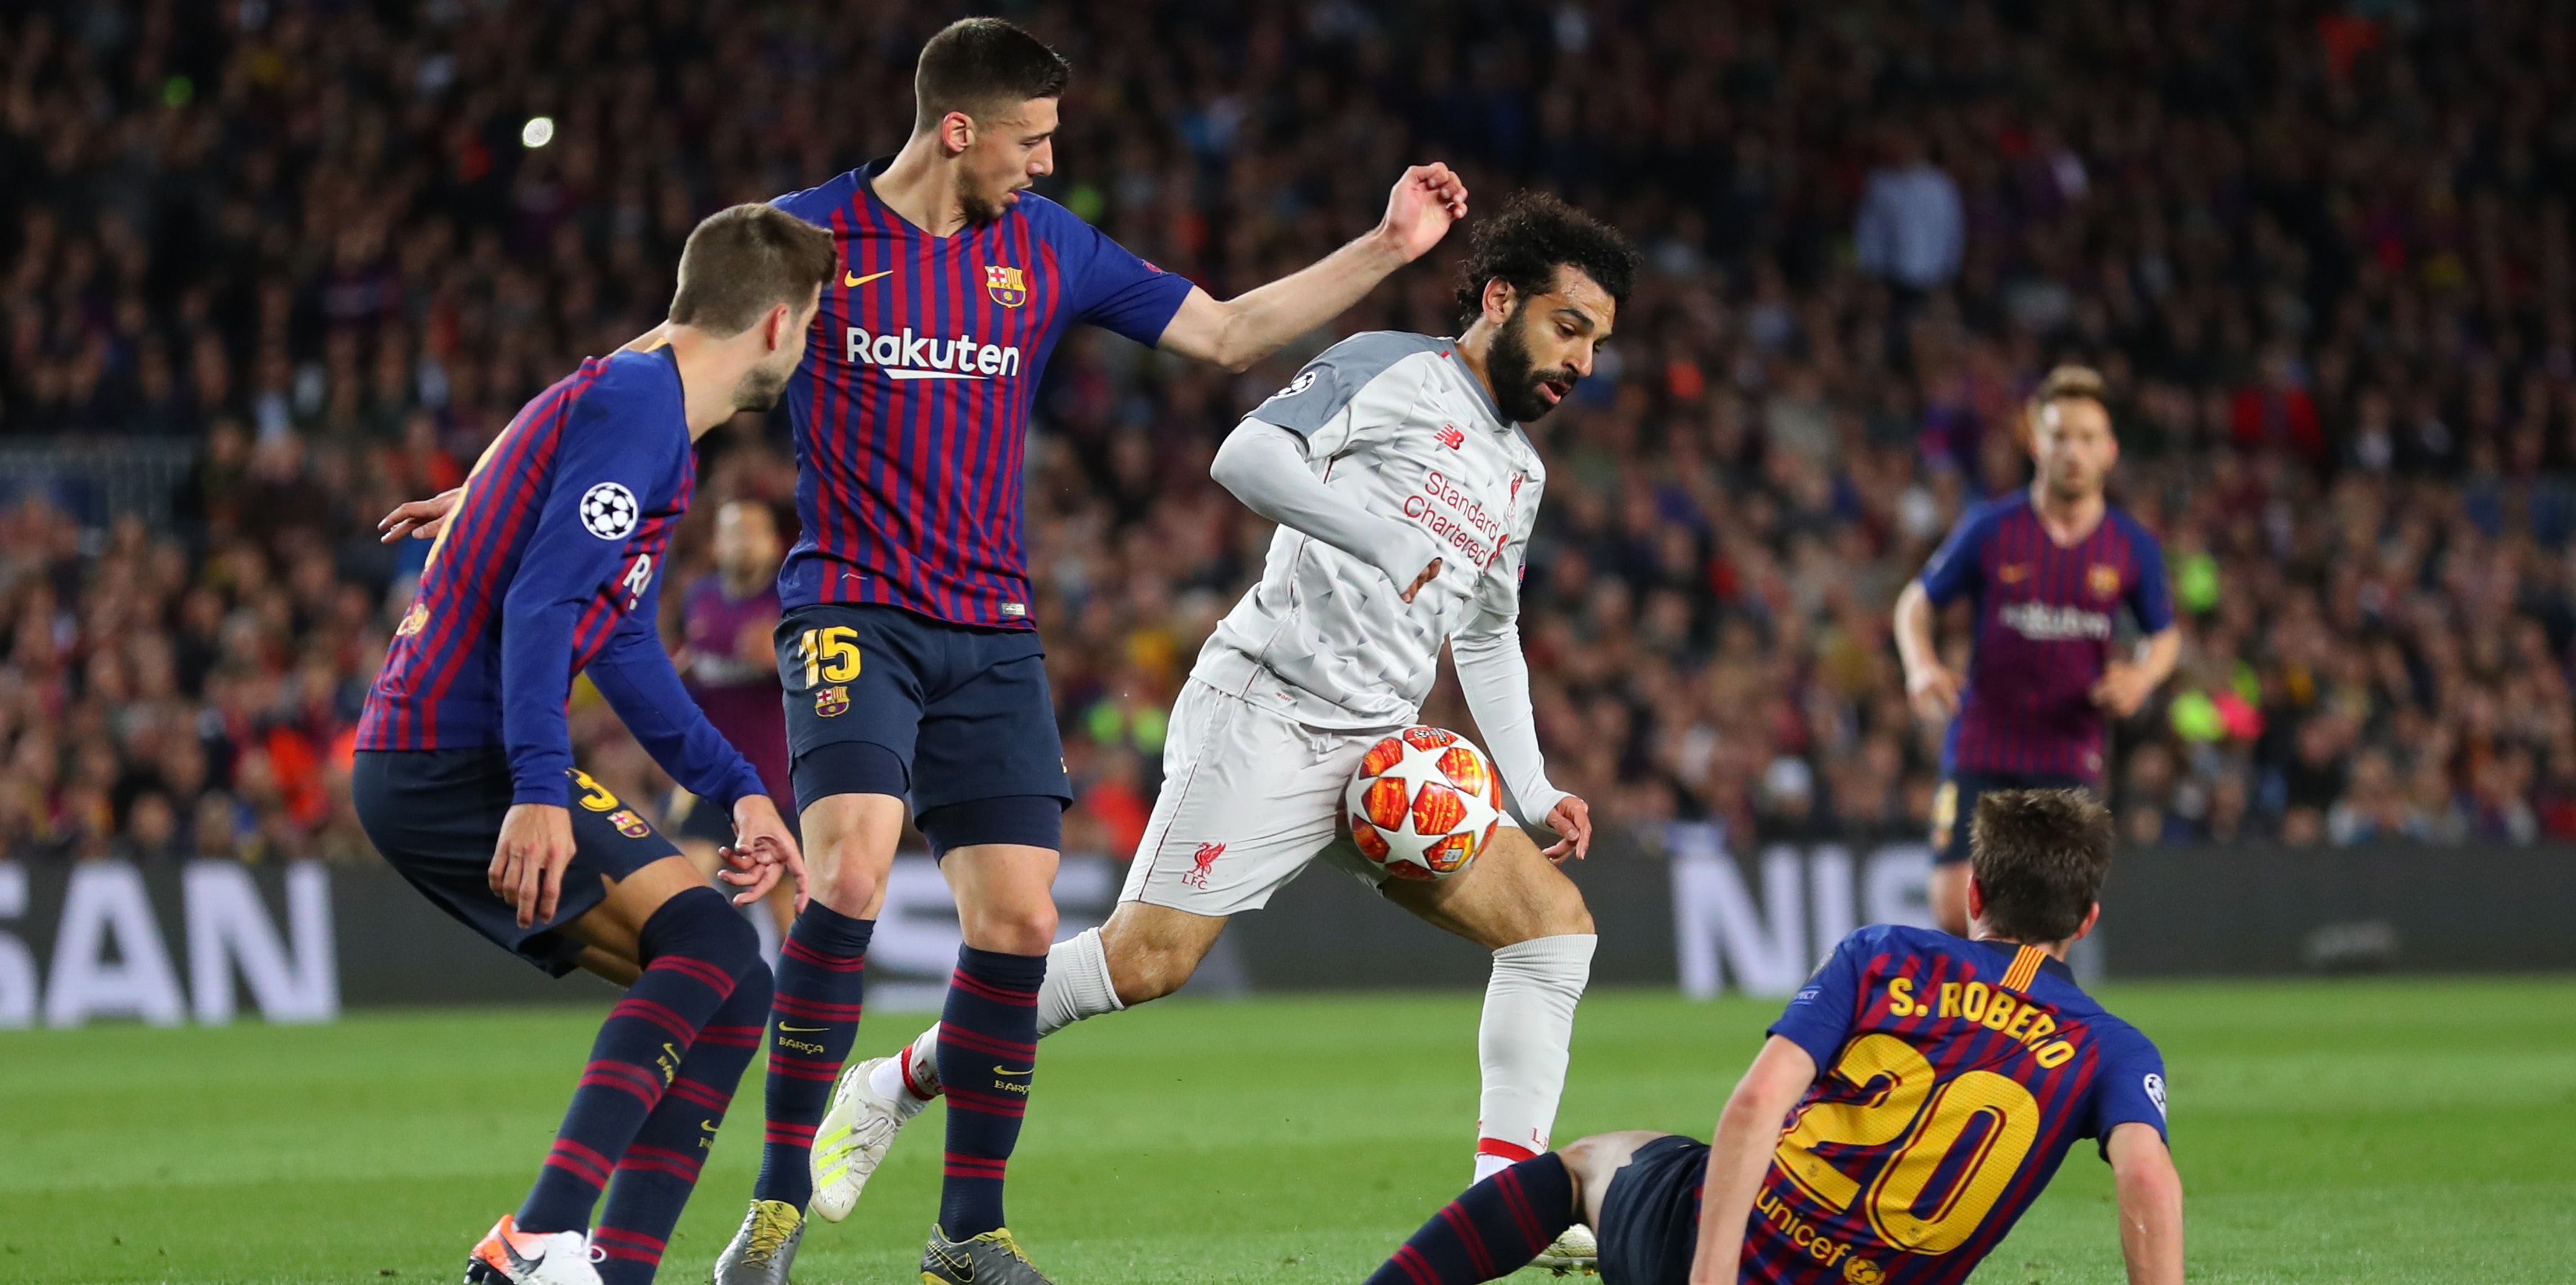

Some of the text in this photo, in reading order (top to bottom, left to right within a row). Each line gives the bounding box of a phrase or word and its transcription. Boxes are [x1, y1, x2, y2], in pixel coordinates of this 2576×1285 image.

[846, 326, 1020, 377] Rakuten
[1403, 495, 1490, 567] Chartered
[1425, 472, 1501, 543] Standard
[798, 626, 862, 690] 15
[565, 767, 619, 813] 3
[0, 860, 339, 1027] AN
[1888, 977, 1929, 1017] S.
[1774, 1032, 2040, 1255] 20
[1755, 1186, 1852, 1268] unicef
